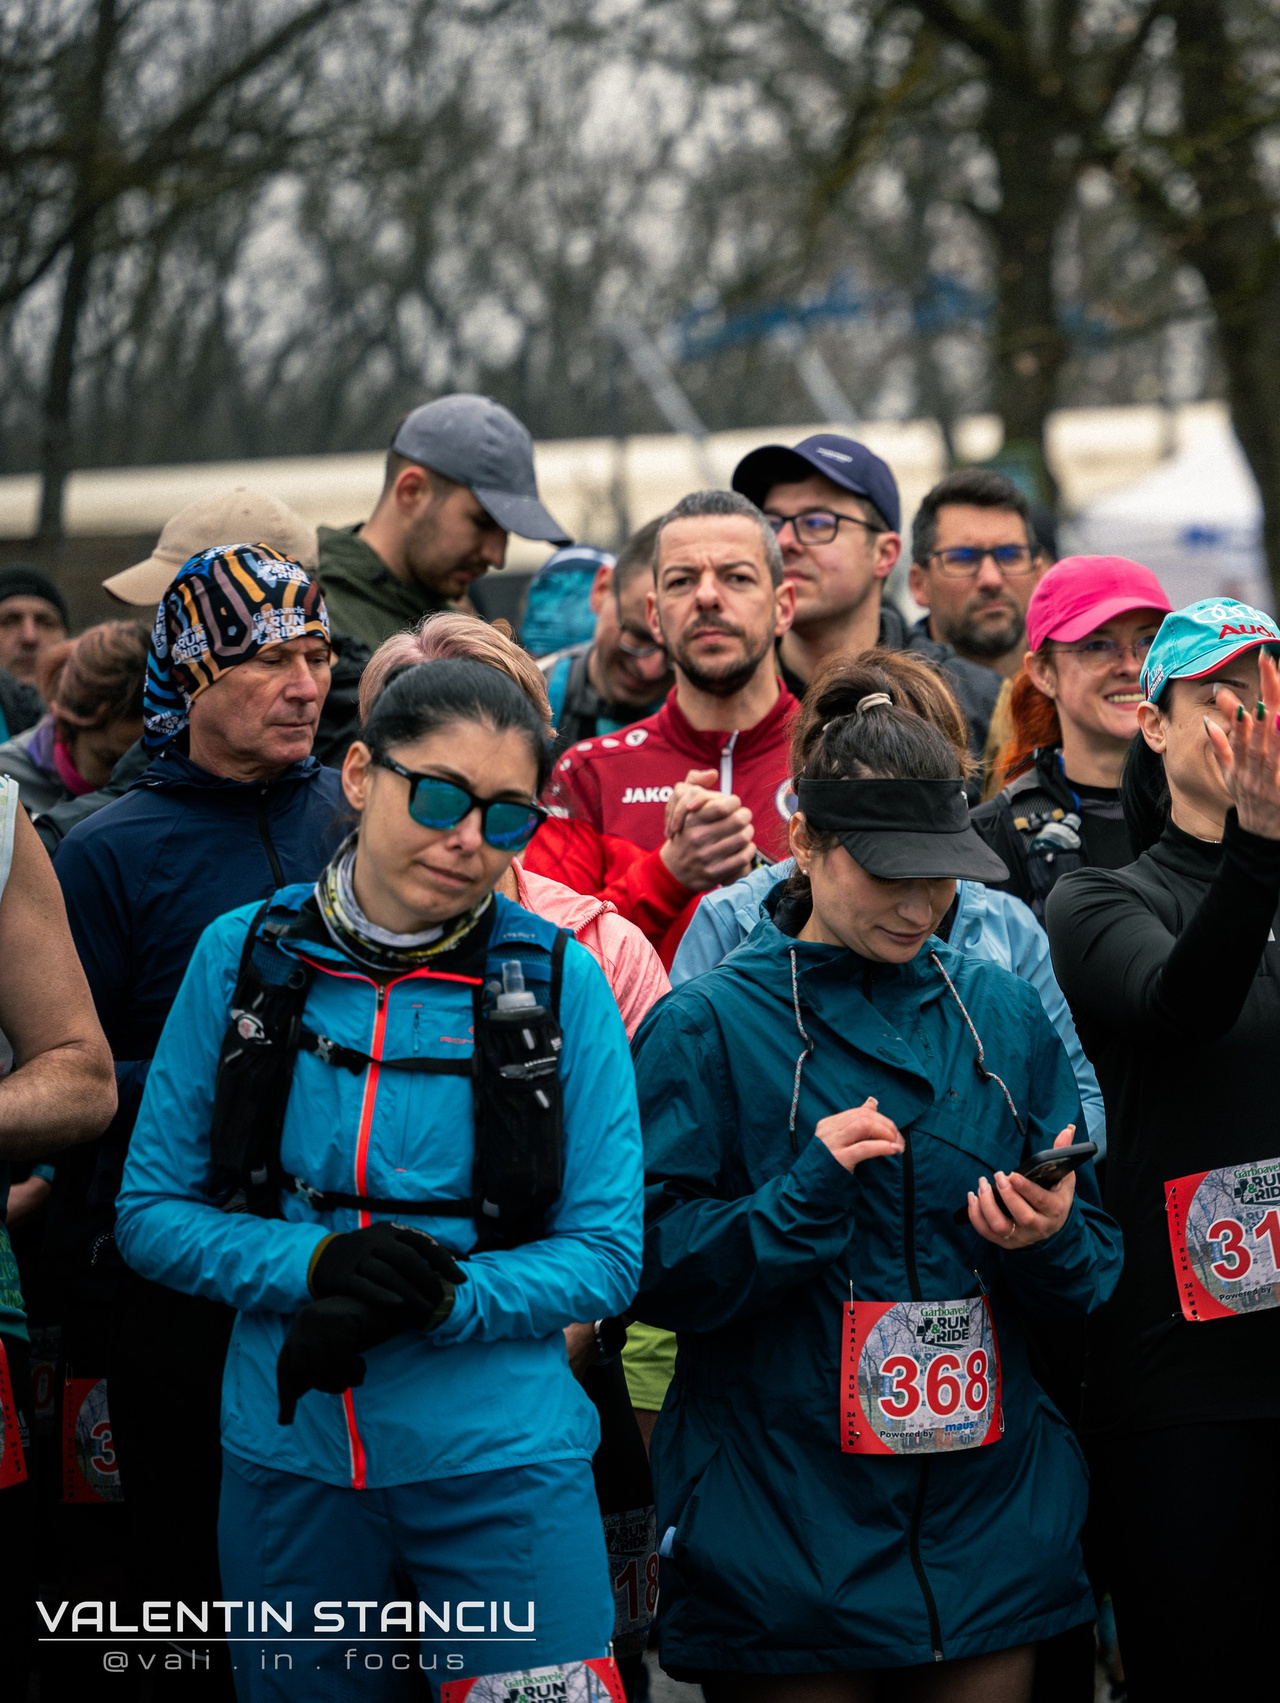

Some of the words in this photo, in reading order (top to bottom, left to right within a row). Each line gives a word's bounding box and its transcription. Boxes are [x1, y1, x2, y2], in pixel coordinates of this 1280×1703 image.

[270, 615, 305, 627] RUN
[178, 631, 207, 647] RUN
[270, 625, 306, 640] RIDE
[180, 641, 209, 660] RIDE
[622, 786, 674, 804] JAKO
[1247, 1183, 1258, 1194] &
[1219, 1287, 1261, 1301] Powered
[1261, 1285, 1272, 1296] by
[930, 1323, 941, 1334] &
[937, 1315, 969, 1329] RUN
[937, 1328, 969, 1342] RIDE
[878, 1347, 990, 1420] 368
[944, 1420, 975, 1432] maus
[879, 1430, 921, 1439] Powered
[922, 1429, 934, 1439] by
[90, 1420, 119, 1475] 3
[620, 1522, 648, 1539] RUN
[620, 1536, 648, 1551] RIDE
[615, 1552, 659, 1622] 18
[524, 1682, 567, 1700] RUN
